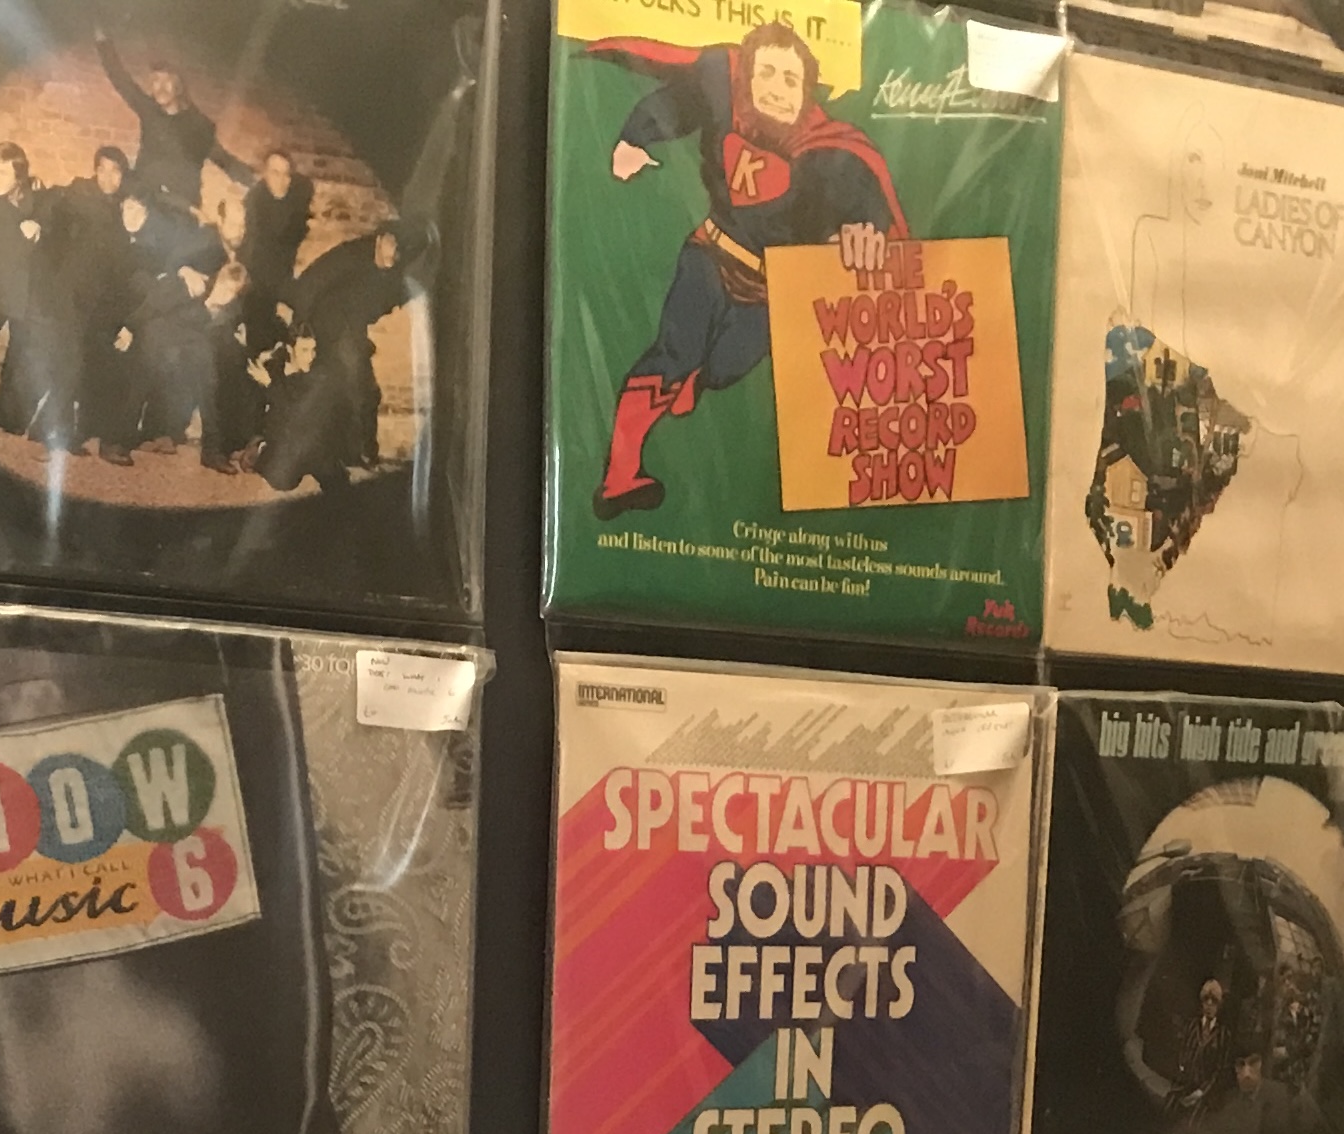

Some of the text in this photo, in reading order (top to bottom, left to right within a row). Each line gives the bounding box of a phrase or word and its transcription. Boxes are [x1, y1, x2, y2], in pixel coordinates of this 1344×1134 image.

[624, 0, 701, 17] LKS
[714, 0, 766, 29] THIS
[774, 9, 795, 30] IS
[731, 150, 764, 196] K
[1233, 185, 1312, 226] LADIES
[1232, 216, 1337, 260] CANYON
[814, 279, 975, 346] WORLD'S
[821, 338, 975, 406] WORST
[828, 402, 978, 457] RECORD
[849, 448, 957, 507] SHOW
[597, 531, 628, 549] and
[633, 532, 677, 554] listen
[679, 539, 695, 555] to
[697, 545, 739, 560] some
[741, 545, 759, 562] of
[759, 546, 783, 565] the
[786, 553, 823, 569] most
[827, 554, 893, 575] tasteless
[894, 562, 947, 579] sounds
[732, 519, 786, 547] Cringe
[788, 527, 830, 550] along
[835, 532, 870, 551] with
[753, 567, 789, 589] Pain
[791, 575, 818, 592] can
[821, 576, 839, 593] be
[577, 683, 666, 706] INTERNATIONAL
[1099, 711, 1131, 759] big
[1133, 712, 1172, 760] hits
[1225, 717, 1262, 764] tide
[1264, 721, 1301, 766] and
[603, 766, 1000, 862] SPECTACULAR
[8, 866, 63, 888] WHAT
[82, 859, 131, 877] CALL
[171, 838, 218, 913] 6
[706, 860, 908, 940] SOUND
[690, 944, 917, 1021] EFFECTS
[773, 1026, 835, 1101] IN
